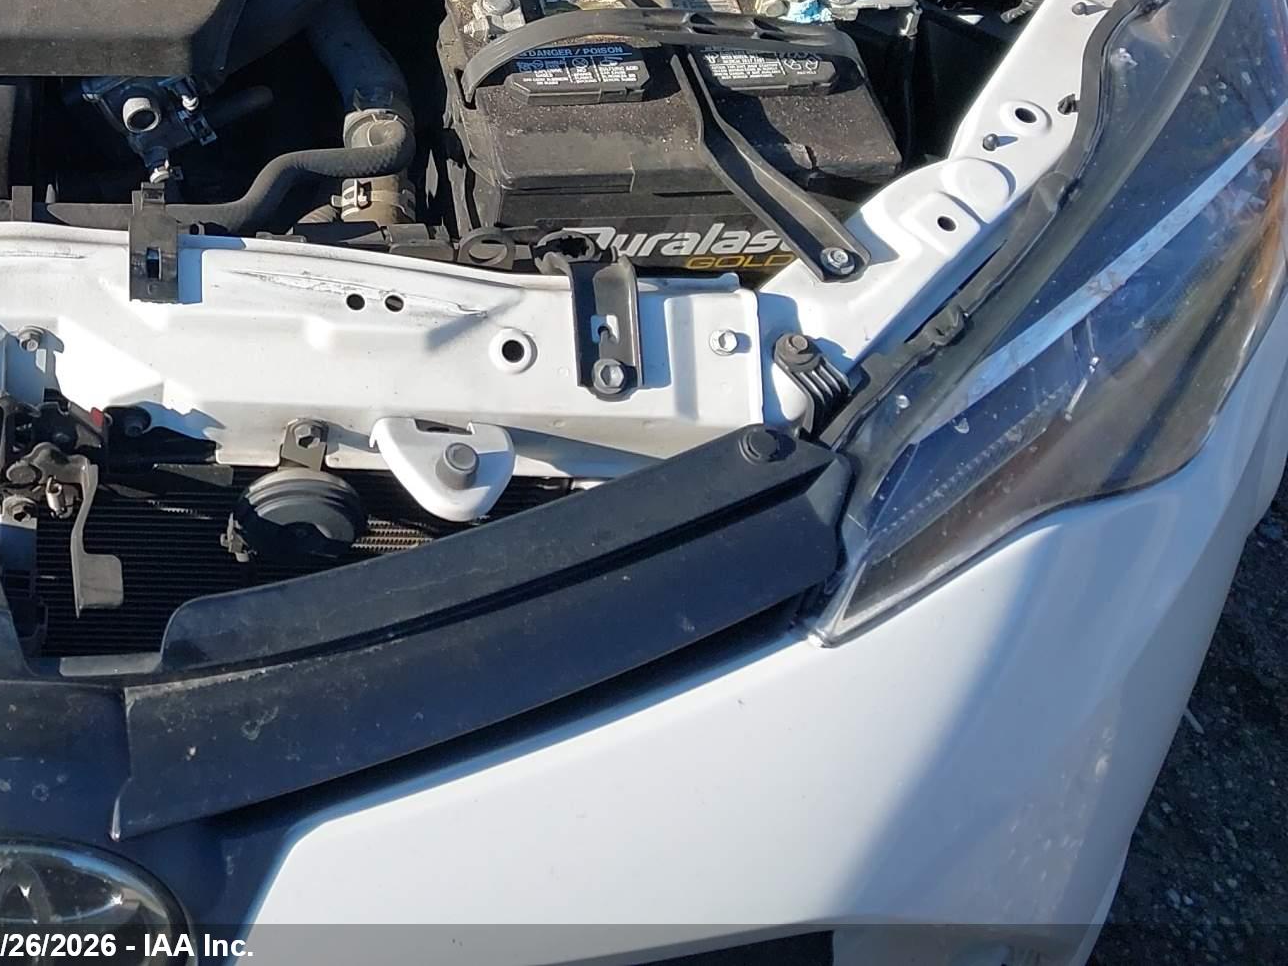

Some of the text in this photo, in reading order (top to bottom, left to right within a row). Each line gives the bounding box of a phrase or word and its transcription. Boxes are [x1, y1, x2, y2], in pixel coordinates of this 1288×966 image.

[528, 47, 572, 57] DANGER
[583, 45, 623, 55] POISON
[563, 223, 792, 256] Duralas
[685, 253, 798, 270] GOLD
